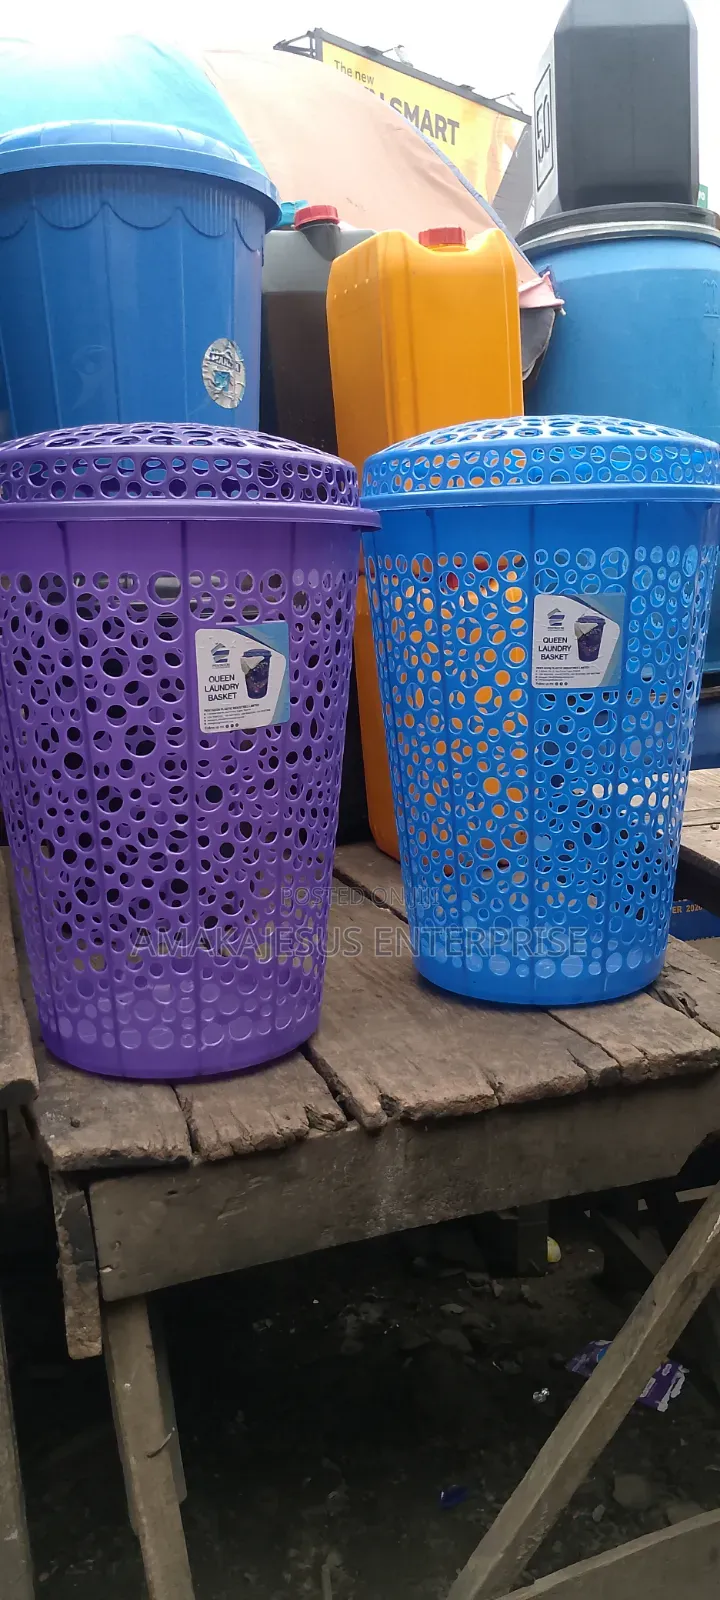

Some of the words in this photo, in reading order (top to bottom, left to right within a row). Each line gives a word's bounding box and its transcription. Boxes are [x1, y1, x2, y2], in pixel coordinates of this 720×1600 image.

[334, 59, 352, 77] The
[354, 70, 374, 86] new
[536, 93, 551, 163] 50
[208, 674, 235, 683] QUEEN
[204, 683, 239, 692] LAUNDRY
[207, 692, 237, 701] BASKET
